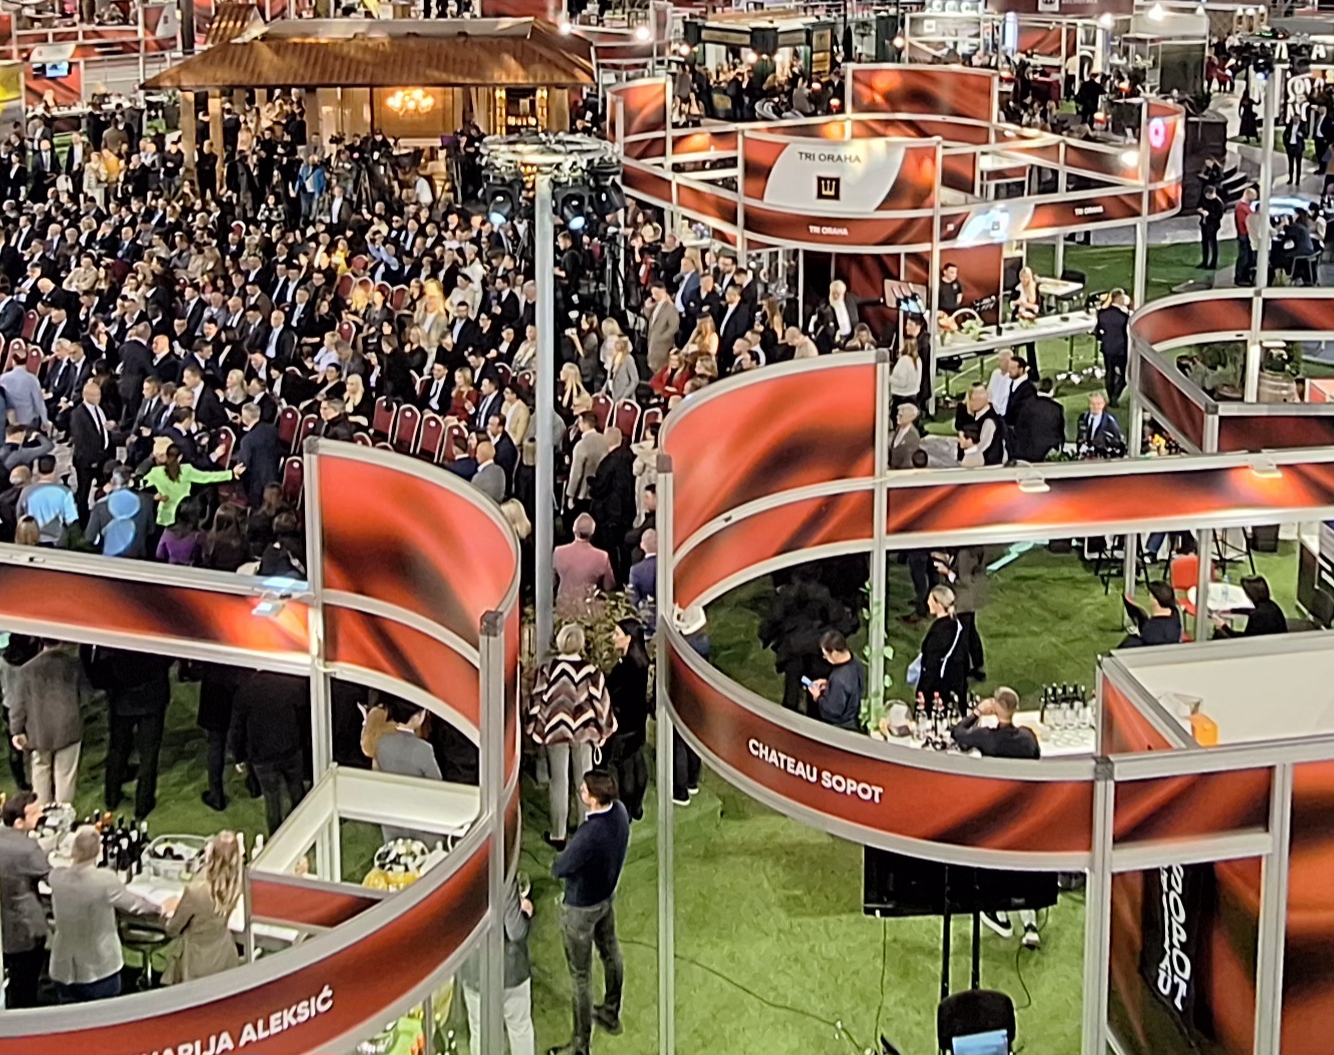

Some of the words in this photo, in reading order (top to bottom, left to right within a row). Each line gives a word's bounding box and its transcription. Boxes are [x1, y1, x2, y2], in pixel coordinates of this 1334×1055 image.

[798, 152, 816, 161] TRI
[818, 152, 862, 164] ORAHA
[809, 225, 820, 234] TRI
[821, 226, 849, 235] ORAHA
[748, 738, 817, 783] CHATEAU
[821, 770, 884, 804] SOPOT
[238, 984, 335, 1047] ALEKSIĆ
